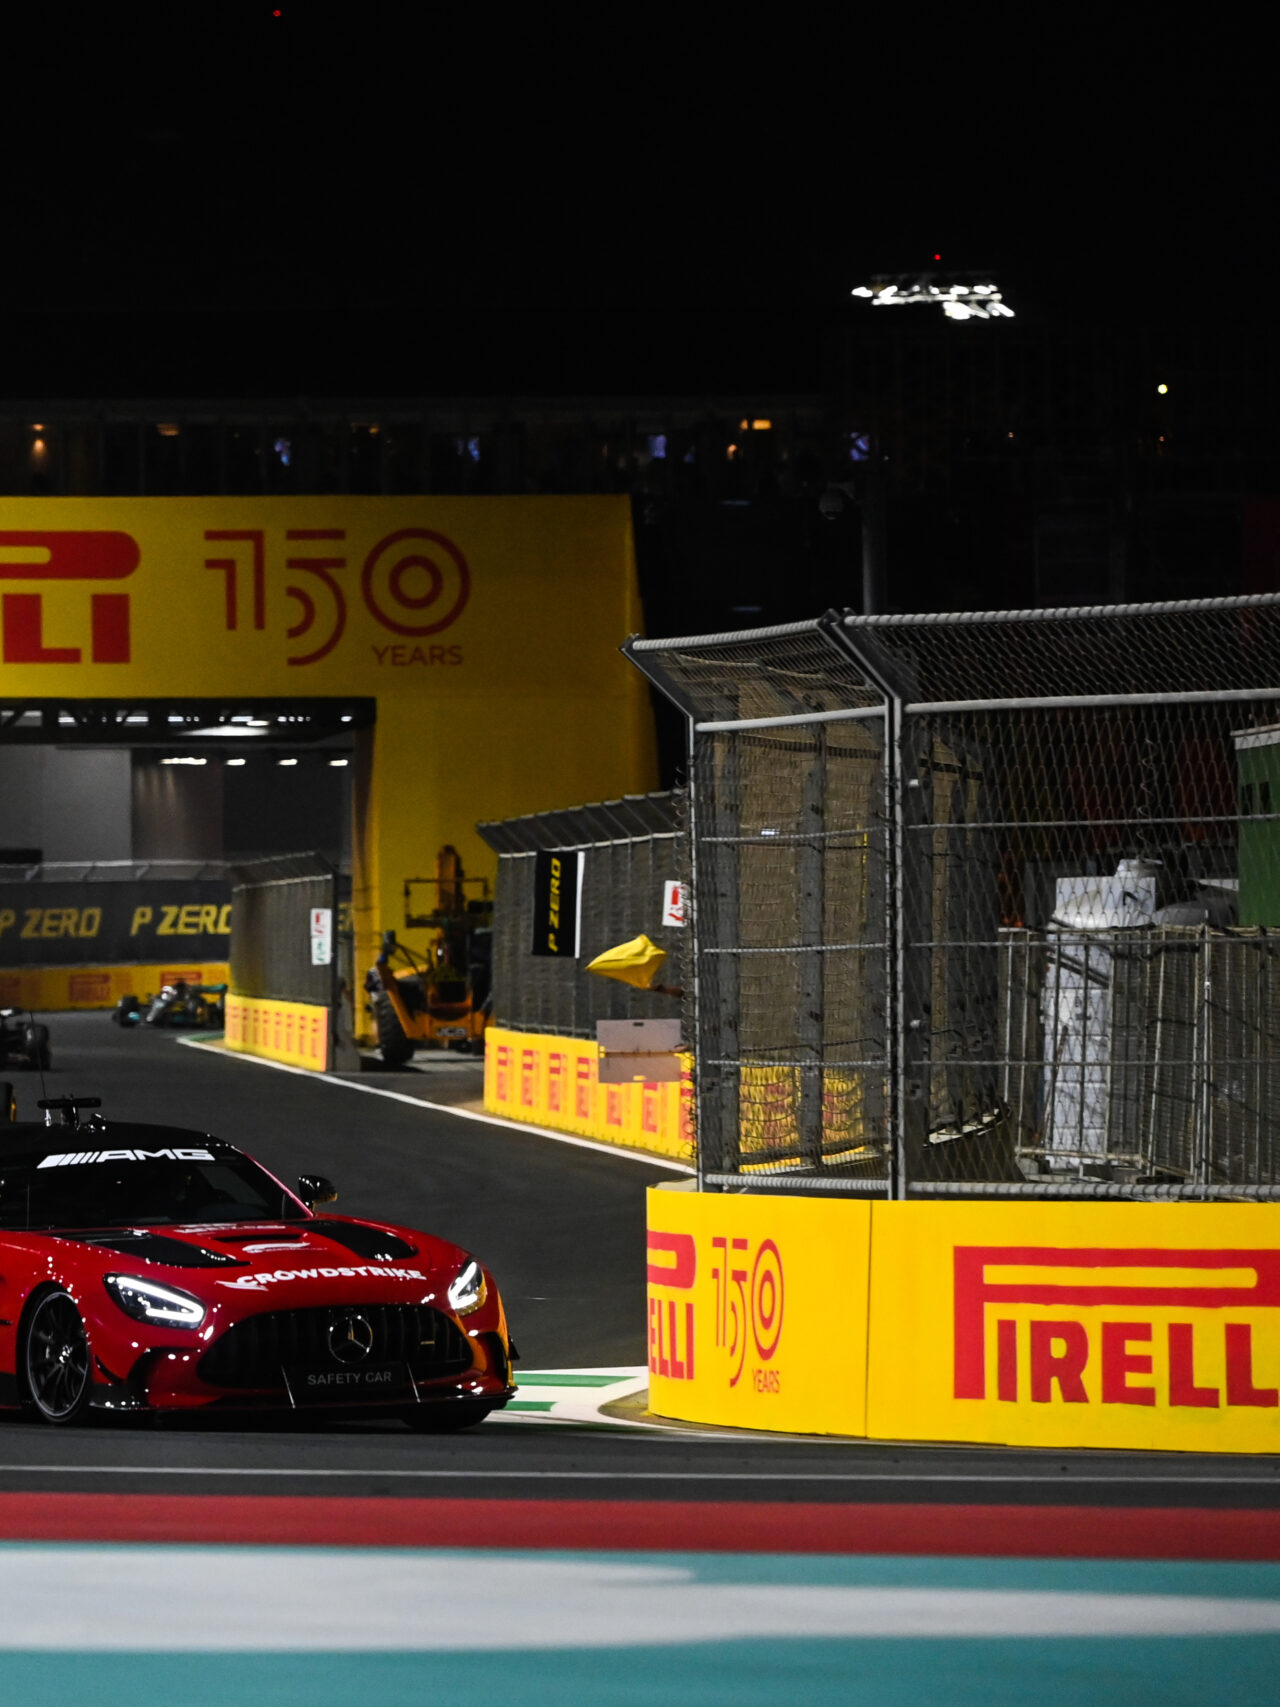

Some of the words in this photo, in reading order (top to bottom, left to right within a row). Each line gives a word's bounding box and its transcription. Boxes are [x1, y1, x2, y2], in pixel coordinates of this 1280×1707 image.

[204, 527, 471, 667] 150
[371, 645, 465, 667] YEARS
[548, 857, 562, 929] ZERO
[20, 907, 102, 939] ZERO
[130, 906, 153, 936] P
[548, 933, 558, 953] P
[96, 1149, 216, 1163] AMG
[236, 1265, 427, 1288] CROWDSTRIKE
[711, 1236, 785, 1388] 150
[953, 1246, 1280, 1408] PIRELL
[307, 1372, 360, 1386] SAFETY
[365, 1371, 392, 1384] CAR
[752, 1369, 781, 1393] YEARS
